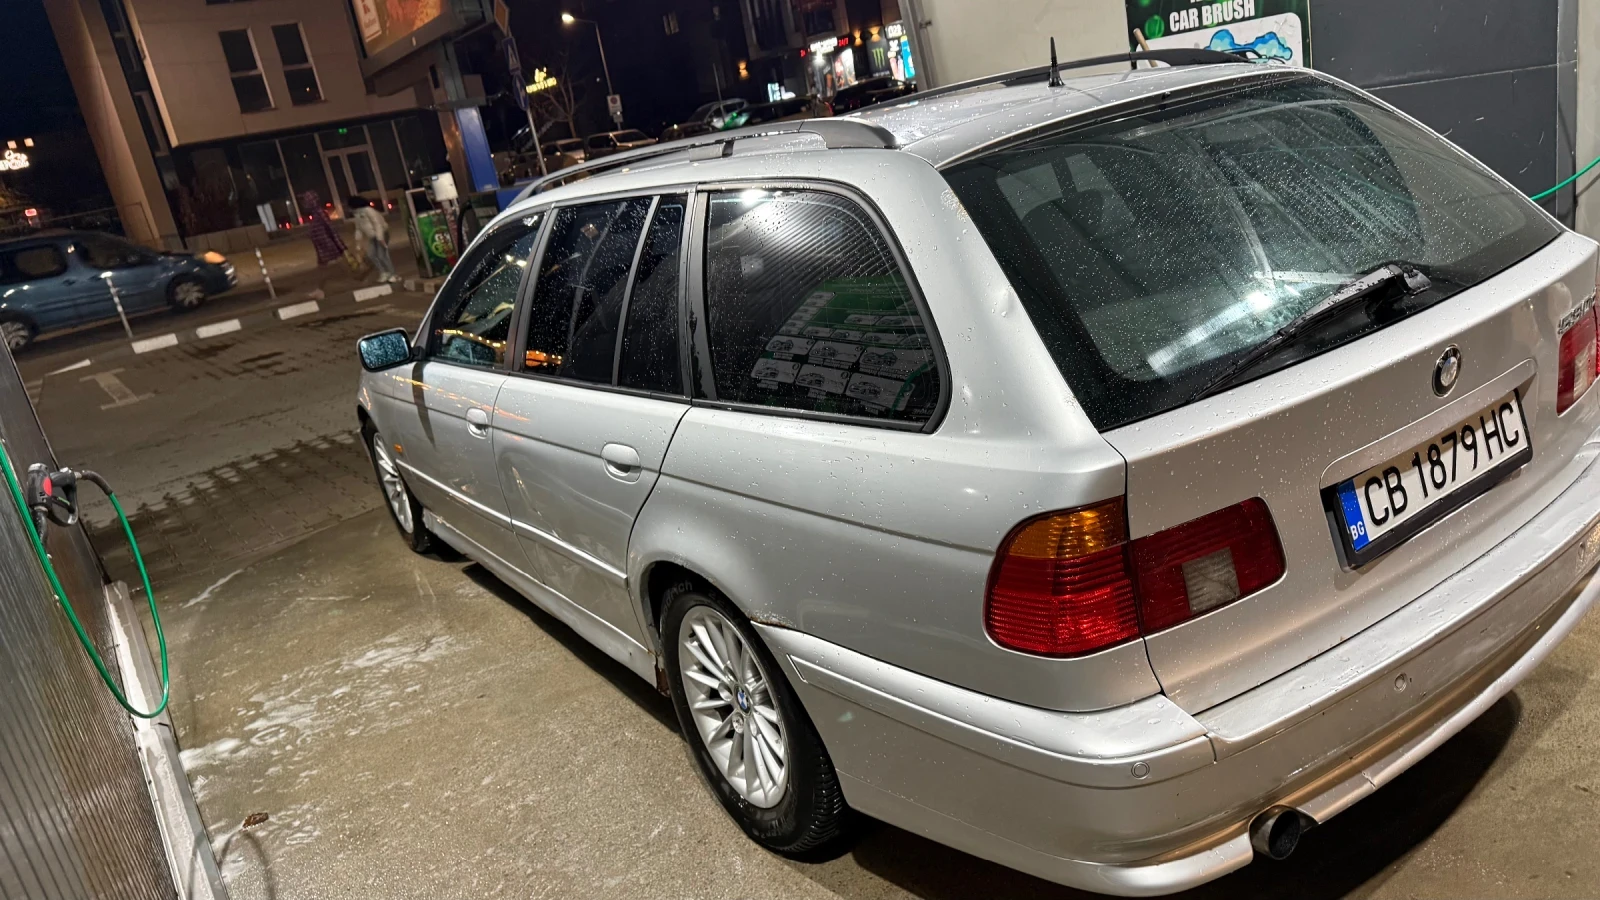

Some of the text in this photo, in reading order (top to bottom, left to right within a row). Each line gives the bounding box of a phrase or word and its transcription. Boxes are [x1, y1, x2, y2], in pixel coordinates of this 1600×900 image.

[1169, 0, 1255, 32] CAR BRUSH
[1364, 402, 1520, 527] CB 1879 HC
[1350, 520, 1365, 541] BG
